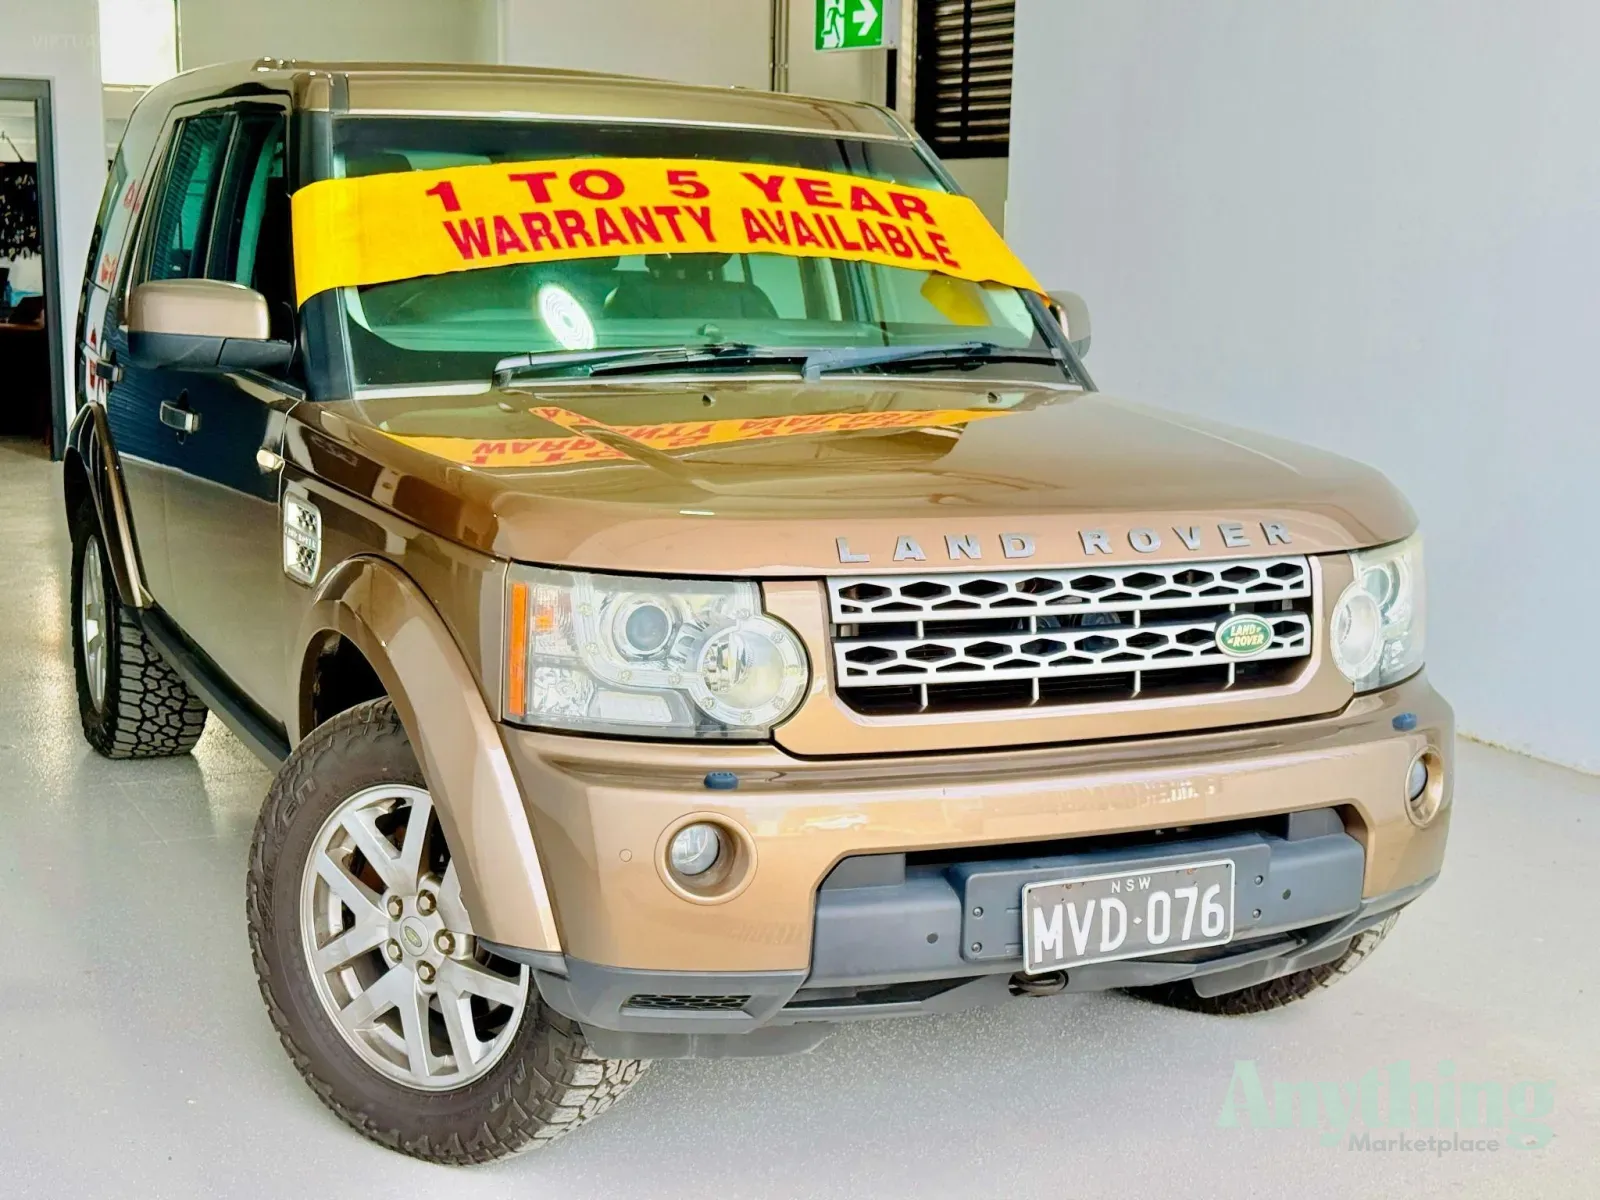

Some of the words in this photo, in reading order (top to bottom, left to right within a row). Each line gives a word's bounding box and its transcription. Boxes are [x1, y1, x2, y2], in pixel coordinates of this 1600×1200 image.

[425, 180, 462, 212] 1
[508, 169, 625, 204] TO
[666, 169, 710, 199] 5
[739, 171, 938, 227] YEAR
[442, 205, 717, 260] WARRANTY
[741, 207, 962, 270] AVAILABLE
[835, 531, 1036, 564] LAND
[1078, 520, 1294, 556] ROVER
[1230, 623, 1257, 637] LAND
[1232, 634, 1265, 647] ROVER
[1111, 876, 1152, 894] NSW
